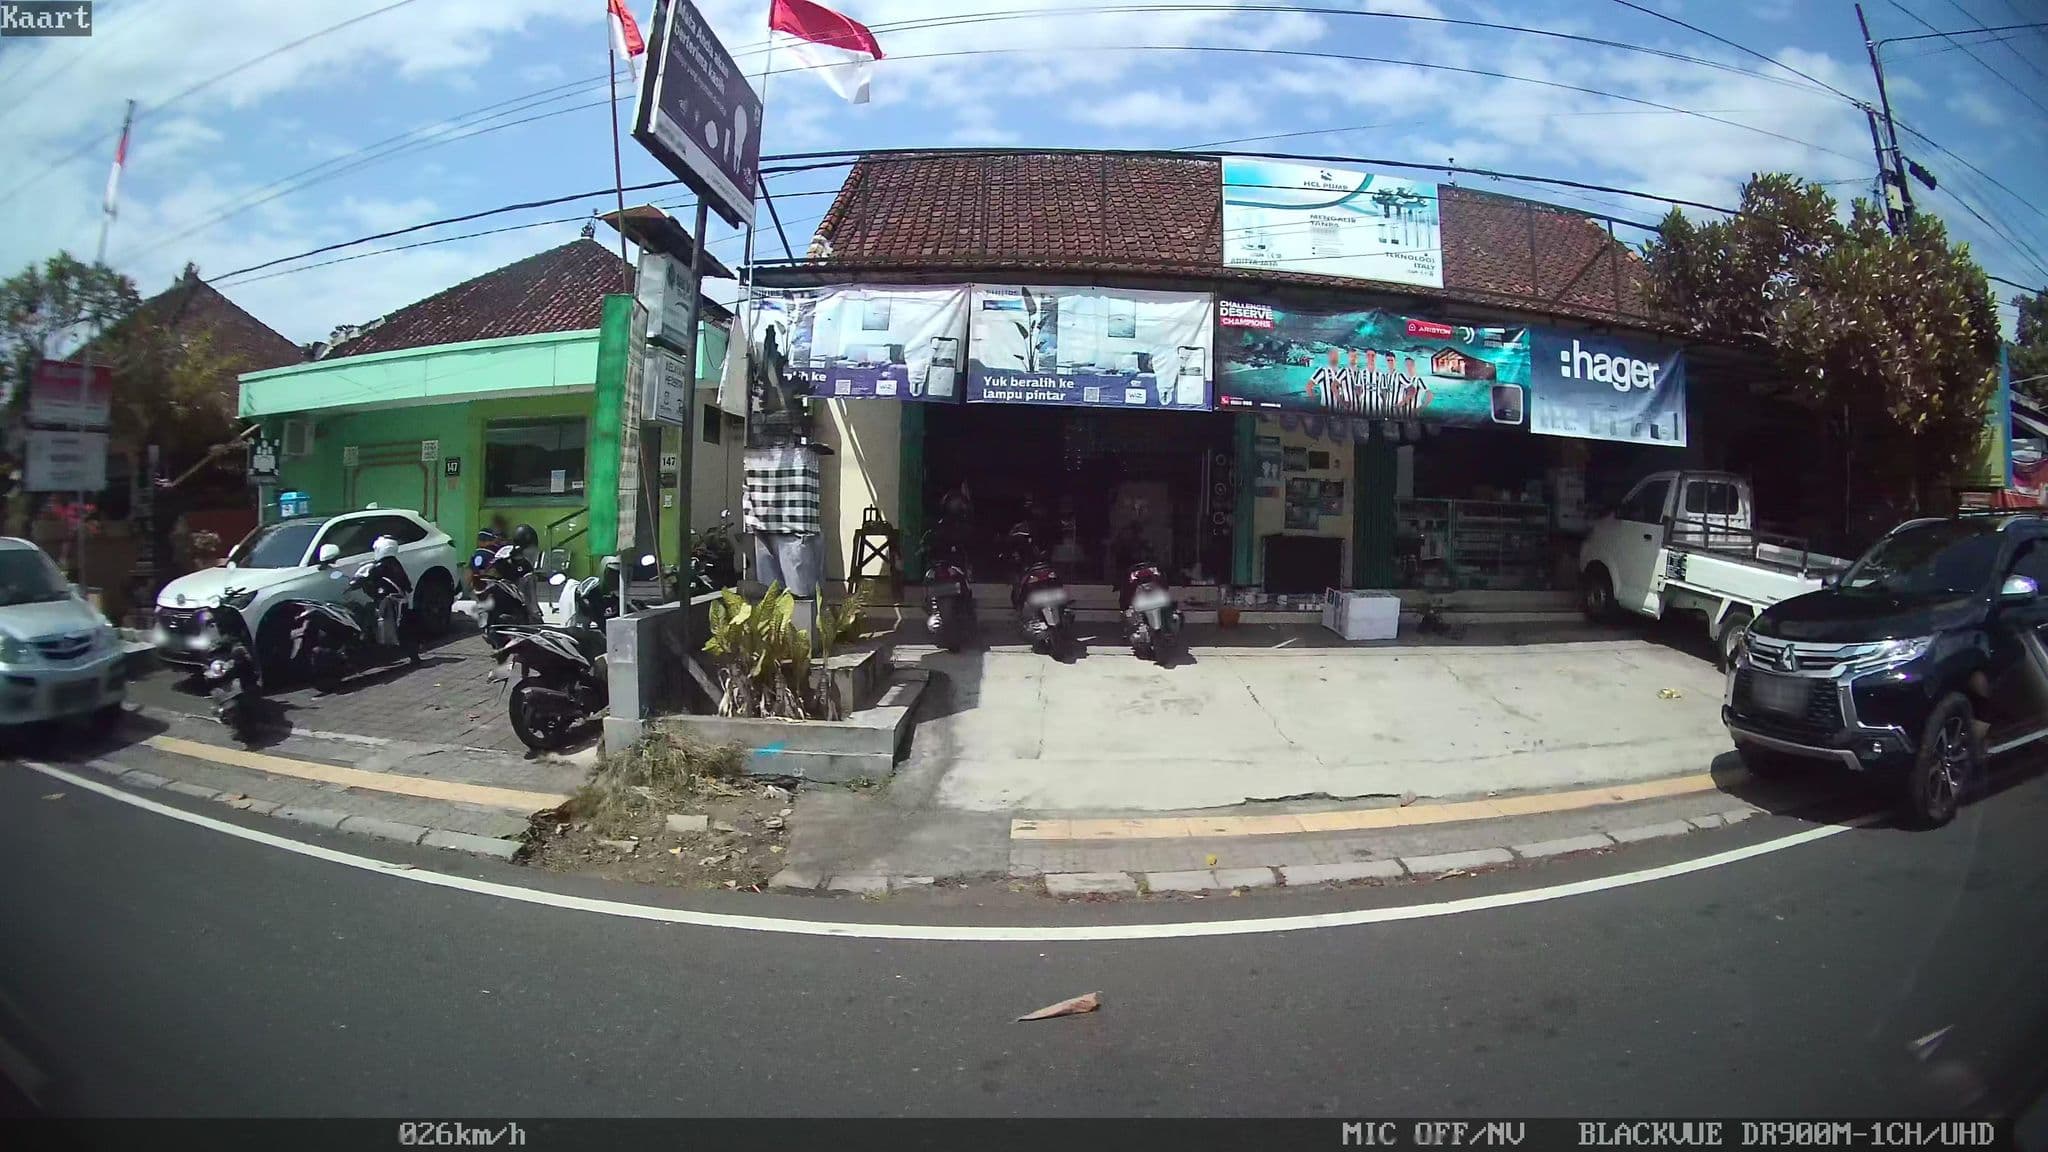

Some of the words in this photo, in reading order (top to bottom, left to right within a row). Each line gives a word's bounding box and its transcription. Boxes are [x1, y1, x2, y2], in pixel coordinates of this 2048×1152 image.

[1413, 262, 1435, 270] ITALY
[1220, 307, 1274, 320] DESERVE
[1222, 317, 1271, 328] CHAMPIONS
[1418, 326, 1451, 335] ARISTON
[811, 371, 827, 382] ke
[983, 376, 1007, 387] Yuk
[1010, 376, 1056, 389] beralih
[1059, 378, 1075, 389] ke
[983, 389, 1022, 401] lampu
[1025, 389, 1066, 401] pintar
[662, 456, 676, 466] 147
[447, 462, 458, 473] 147
